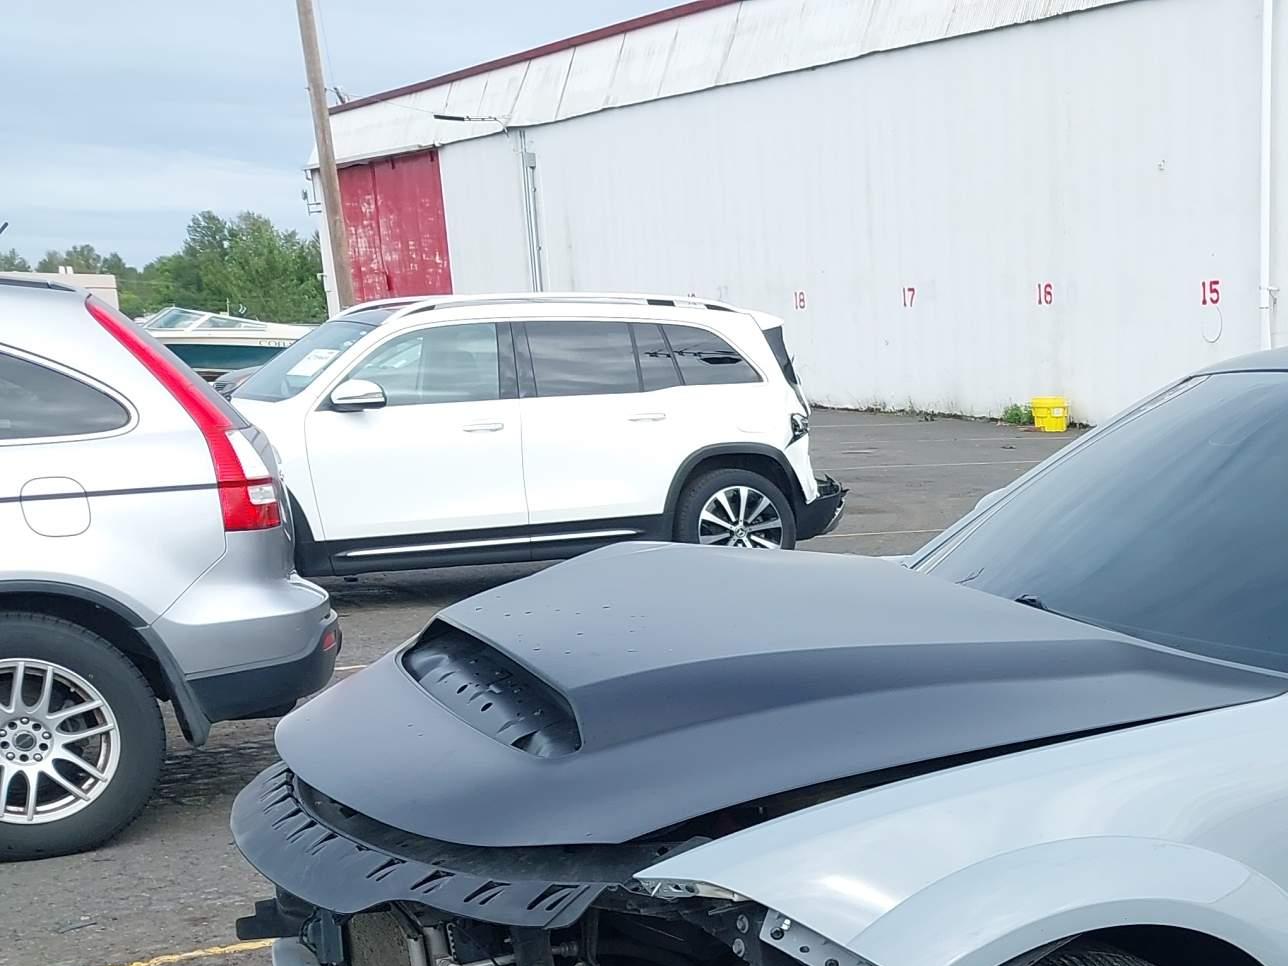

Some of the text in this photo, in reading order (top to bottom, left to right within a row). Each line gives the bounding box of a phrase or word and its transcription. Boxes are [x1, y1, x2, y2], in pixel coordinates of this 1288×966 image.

[792, 291, 806, 310] 18
[902, 287, 915, 307] 17
[1037, 283, 1053, 305] 16
[1201, 280, 1220, 305] 15
